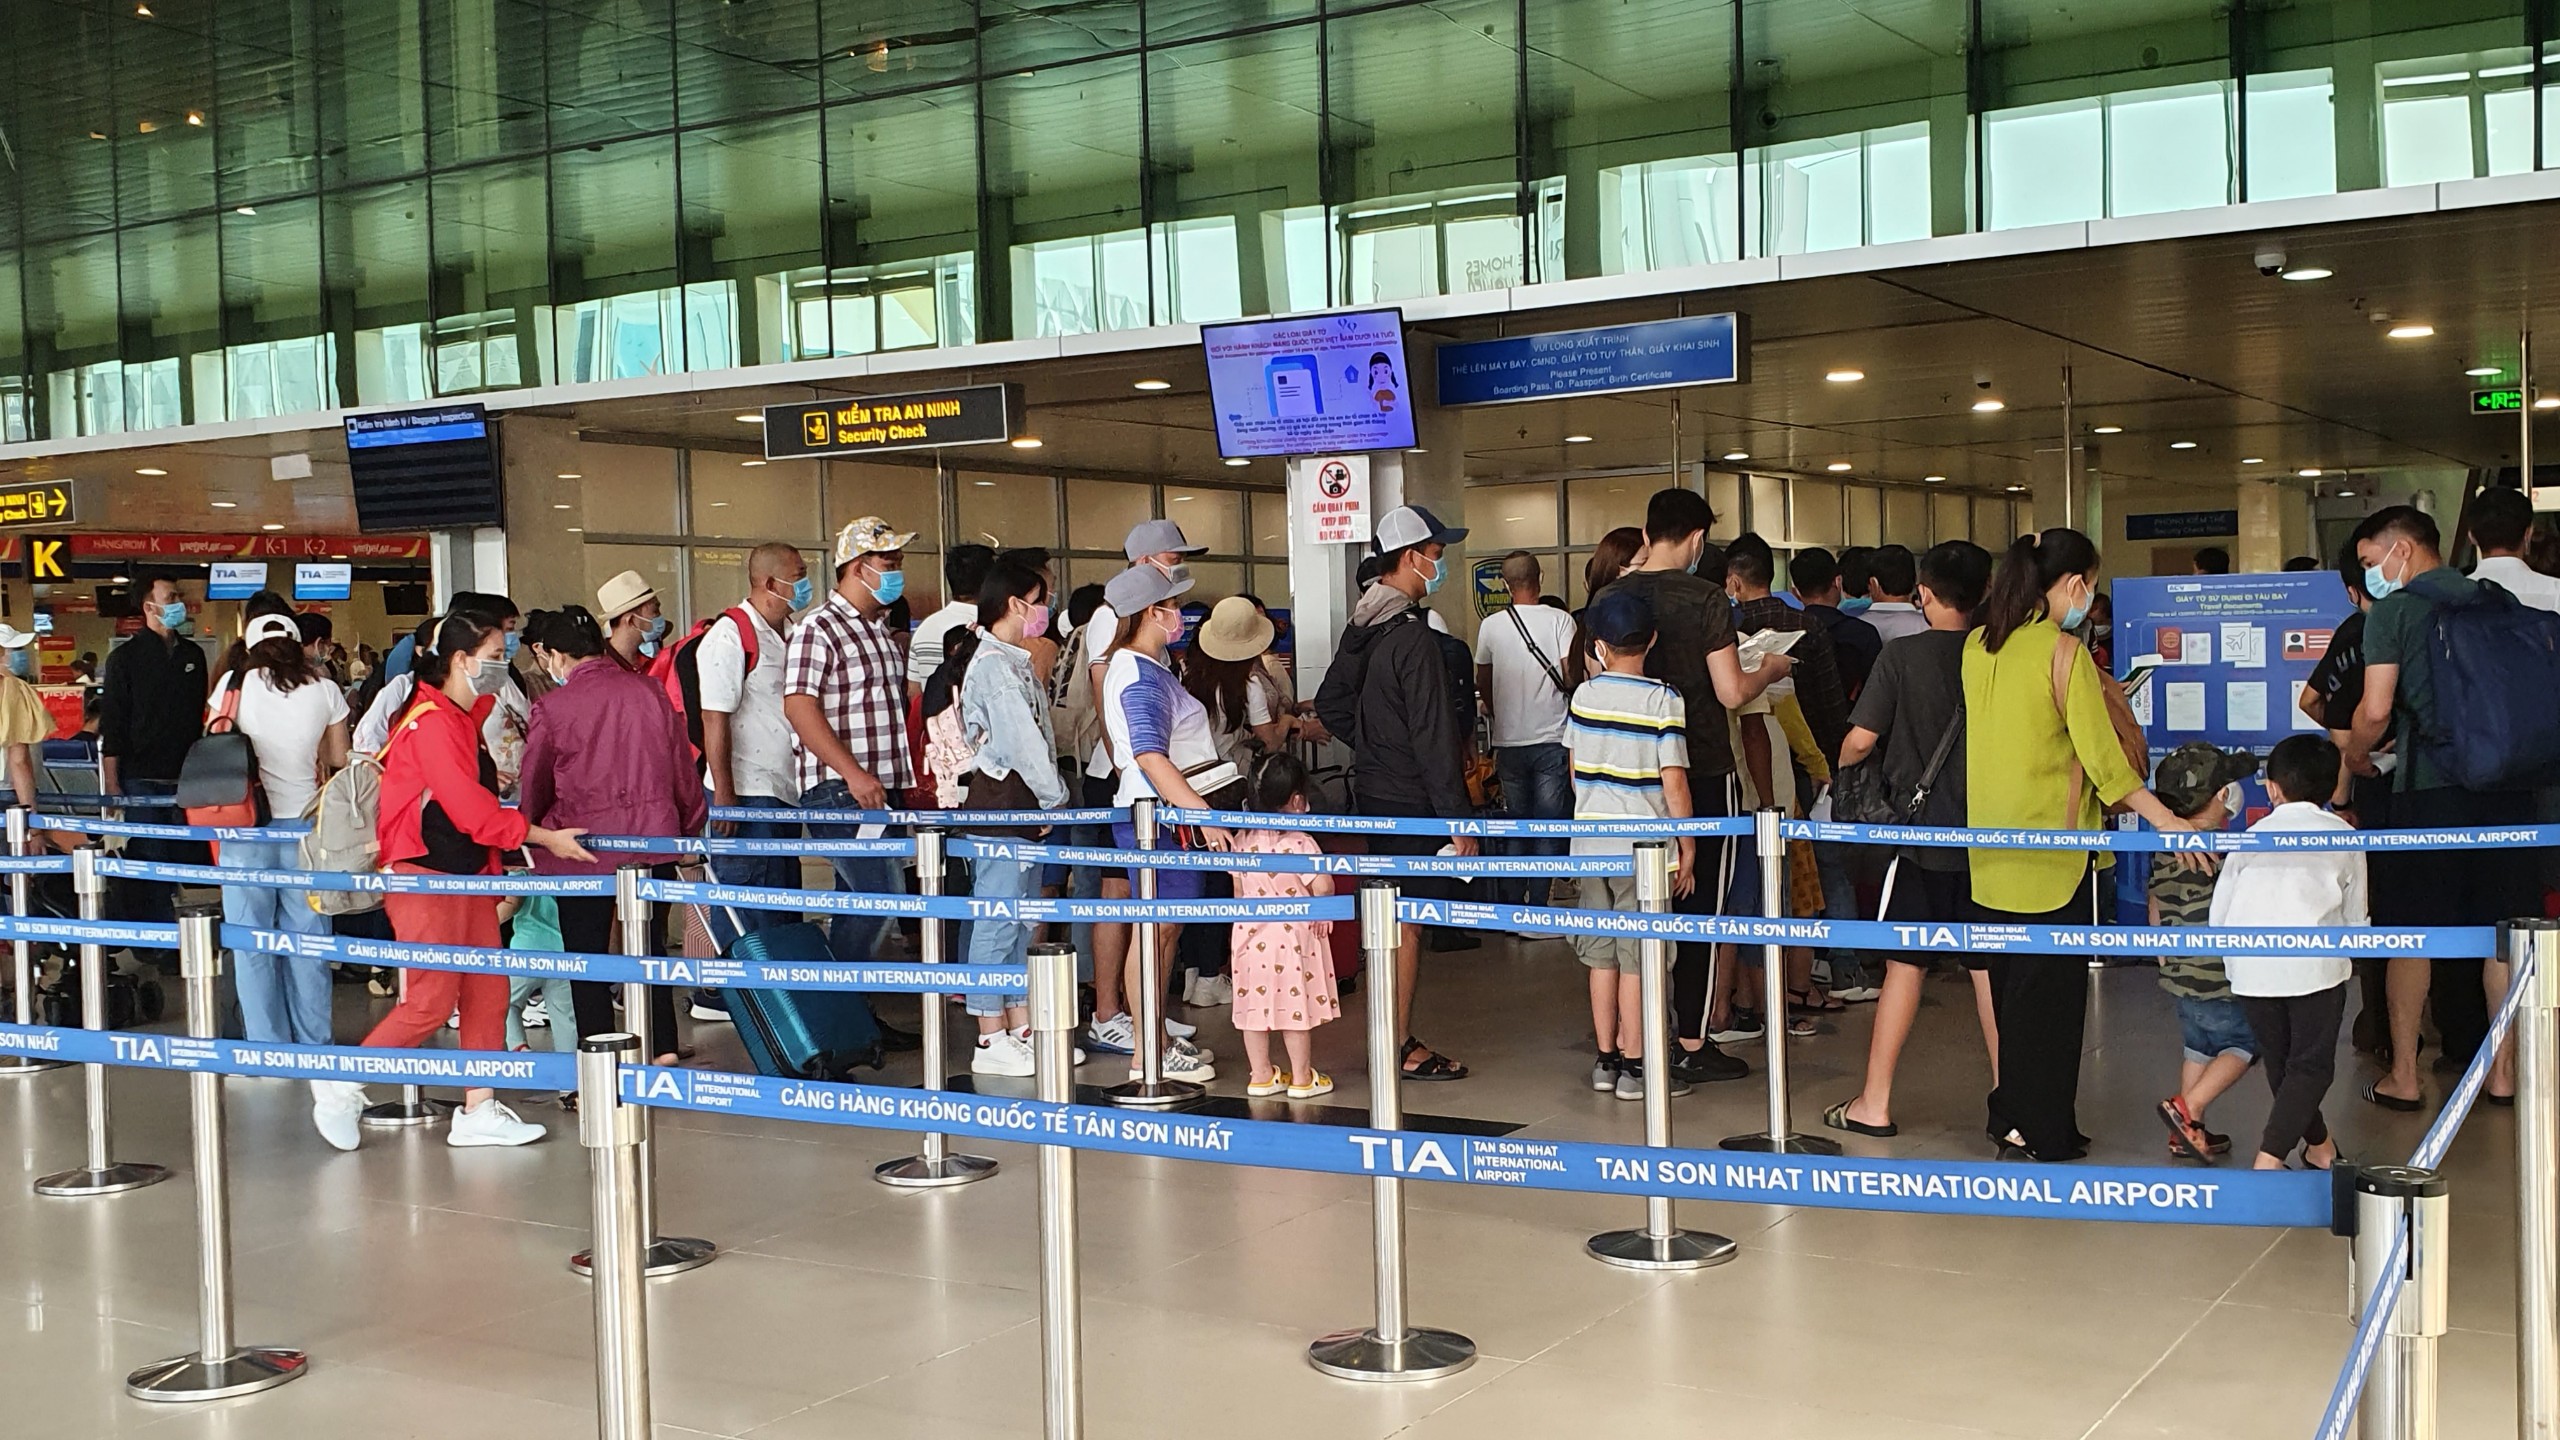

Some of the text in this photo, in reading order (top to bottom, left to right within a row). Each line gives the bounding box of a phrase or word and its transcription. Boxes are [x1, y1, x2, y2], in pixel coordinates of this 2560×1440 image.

[1550, 366, 1612, 379] Please Present
[1493, 384, 1528, 396] Boarding
[1609, 373, 1628, 384] Birth
[1631, 370, 1672, 381] Certificate
[837, 400, 960, 426] KIỂM TRA AN NINH
[838, 423, 927, 444] Security Check
[151, 537, 160, 552] K
[266, 539, 287, 554] K-1
[304, 539, 326, 555] K-2
[32, 540, 64, 578] K
[215, 570, 237, 578] TIA
[300, 570, 322, 578] TIA
[889, 812, 920, 823] TIA
[1446, 821, 1481, 833] TIA
[1529, 822, 1721, 832] TAN SON NHAT INTERNATIONAL AIRPORT
[673, 839, 706, 852] TIA
[2159, 835, 2207, 849] TIA
[2273, 831, 2538, 846] TAN SON NHAT INTERNATIONAL AIRPORT
[974, 843, 1013, 858] TIA
[1309, 857, 1353, 872] TIA
[1408, 861, 1631, 871] TAN SON NHAT INTERNATIONAL AIRPORT
[352, 875, 386, 890] TIA
[708, 888, 736, 901] CẢNG
[738, 889, 765, 902] HÀNG
[767, 891, 803, 904] KHÔNG
[805, 892, 835, 906] QUỐC
[837, 893, 850, 907] TẾ
[852, 895, 872, 908] TÂN
[875, 898, 898, 910] SƠN
[900, 897, 928, 911] NHẤT
[968, 901, 1013, 917] TIA
[1396, 901, 1442, 921] TIA
[1513, 910, 1831, 939] CẢNG HÀNG KHÔNG QUỐC TẾ TÂN SƠN NHẤT
[251, 931, 295, 953] TIA
[1893, 927, 1959, 947] TIA
[2050, 933, 2426, 949] TAN SON NHAT INTERNATIONAL AIRPORT
[348, 943, 377, 959] CẢNG
[380, 945, 410, 961] HÀNG
[412, 947, 451, 964] KHÔNG
[453, 948, 485, 966] QUỐC
[488, 950, 502, 967] TẾ
[504, 953, 528, 969] TÂN
[530, 957, 554, 971] SƠN
[557, 955, 589, 973] NHẤT
[639, 960, 694, 982] TIA
[761, 967, 787, 981] TAN
[791, 968, 820, 982] SON
[823, 969, 860, 983] NHAT
[863, 970, 975, 985] INTERNATIONAL
[978, 972, 1027, 986] AIRPO
[109, 1037, 162, 1063] TIA
[233, 1050, 261, 1066] TAN
[264, 1052, 295, 1067] SON
[297, 1053, 337, 1069] NHAT
[340, 1054, 462, 1075] INTERNATIONAL
[464, 1059, 535, 1078] AIRPORT
[696, 1072, 755, 1086] TAN SON NHAT
[695, 1085, 761, 1098] INTERNATIONAL
[695, 1096, 732, 1106] AIRPORT
[780, 1085, 1233, 1151] CẢNG HÀNG KHÔNG QUỐC TẾ TÂN SƠN NHẤT
[1473, 1141, 1558, 1156] TAN SON NHAT
[1348, 1137, 1457, 1178] TIA
[1474, 1155, 1567, 1171] INTERNATIONAL
[1475, 1170, 1526, 1183] AIRPORT
[1595, 1157, 2219, 1209] TAN SON NHAT INTERNATIONAL AIRPORT
